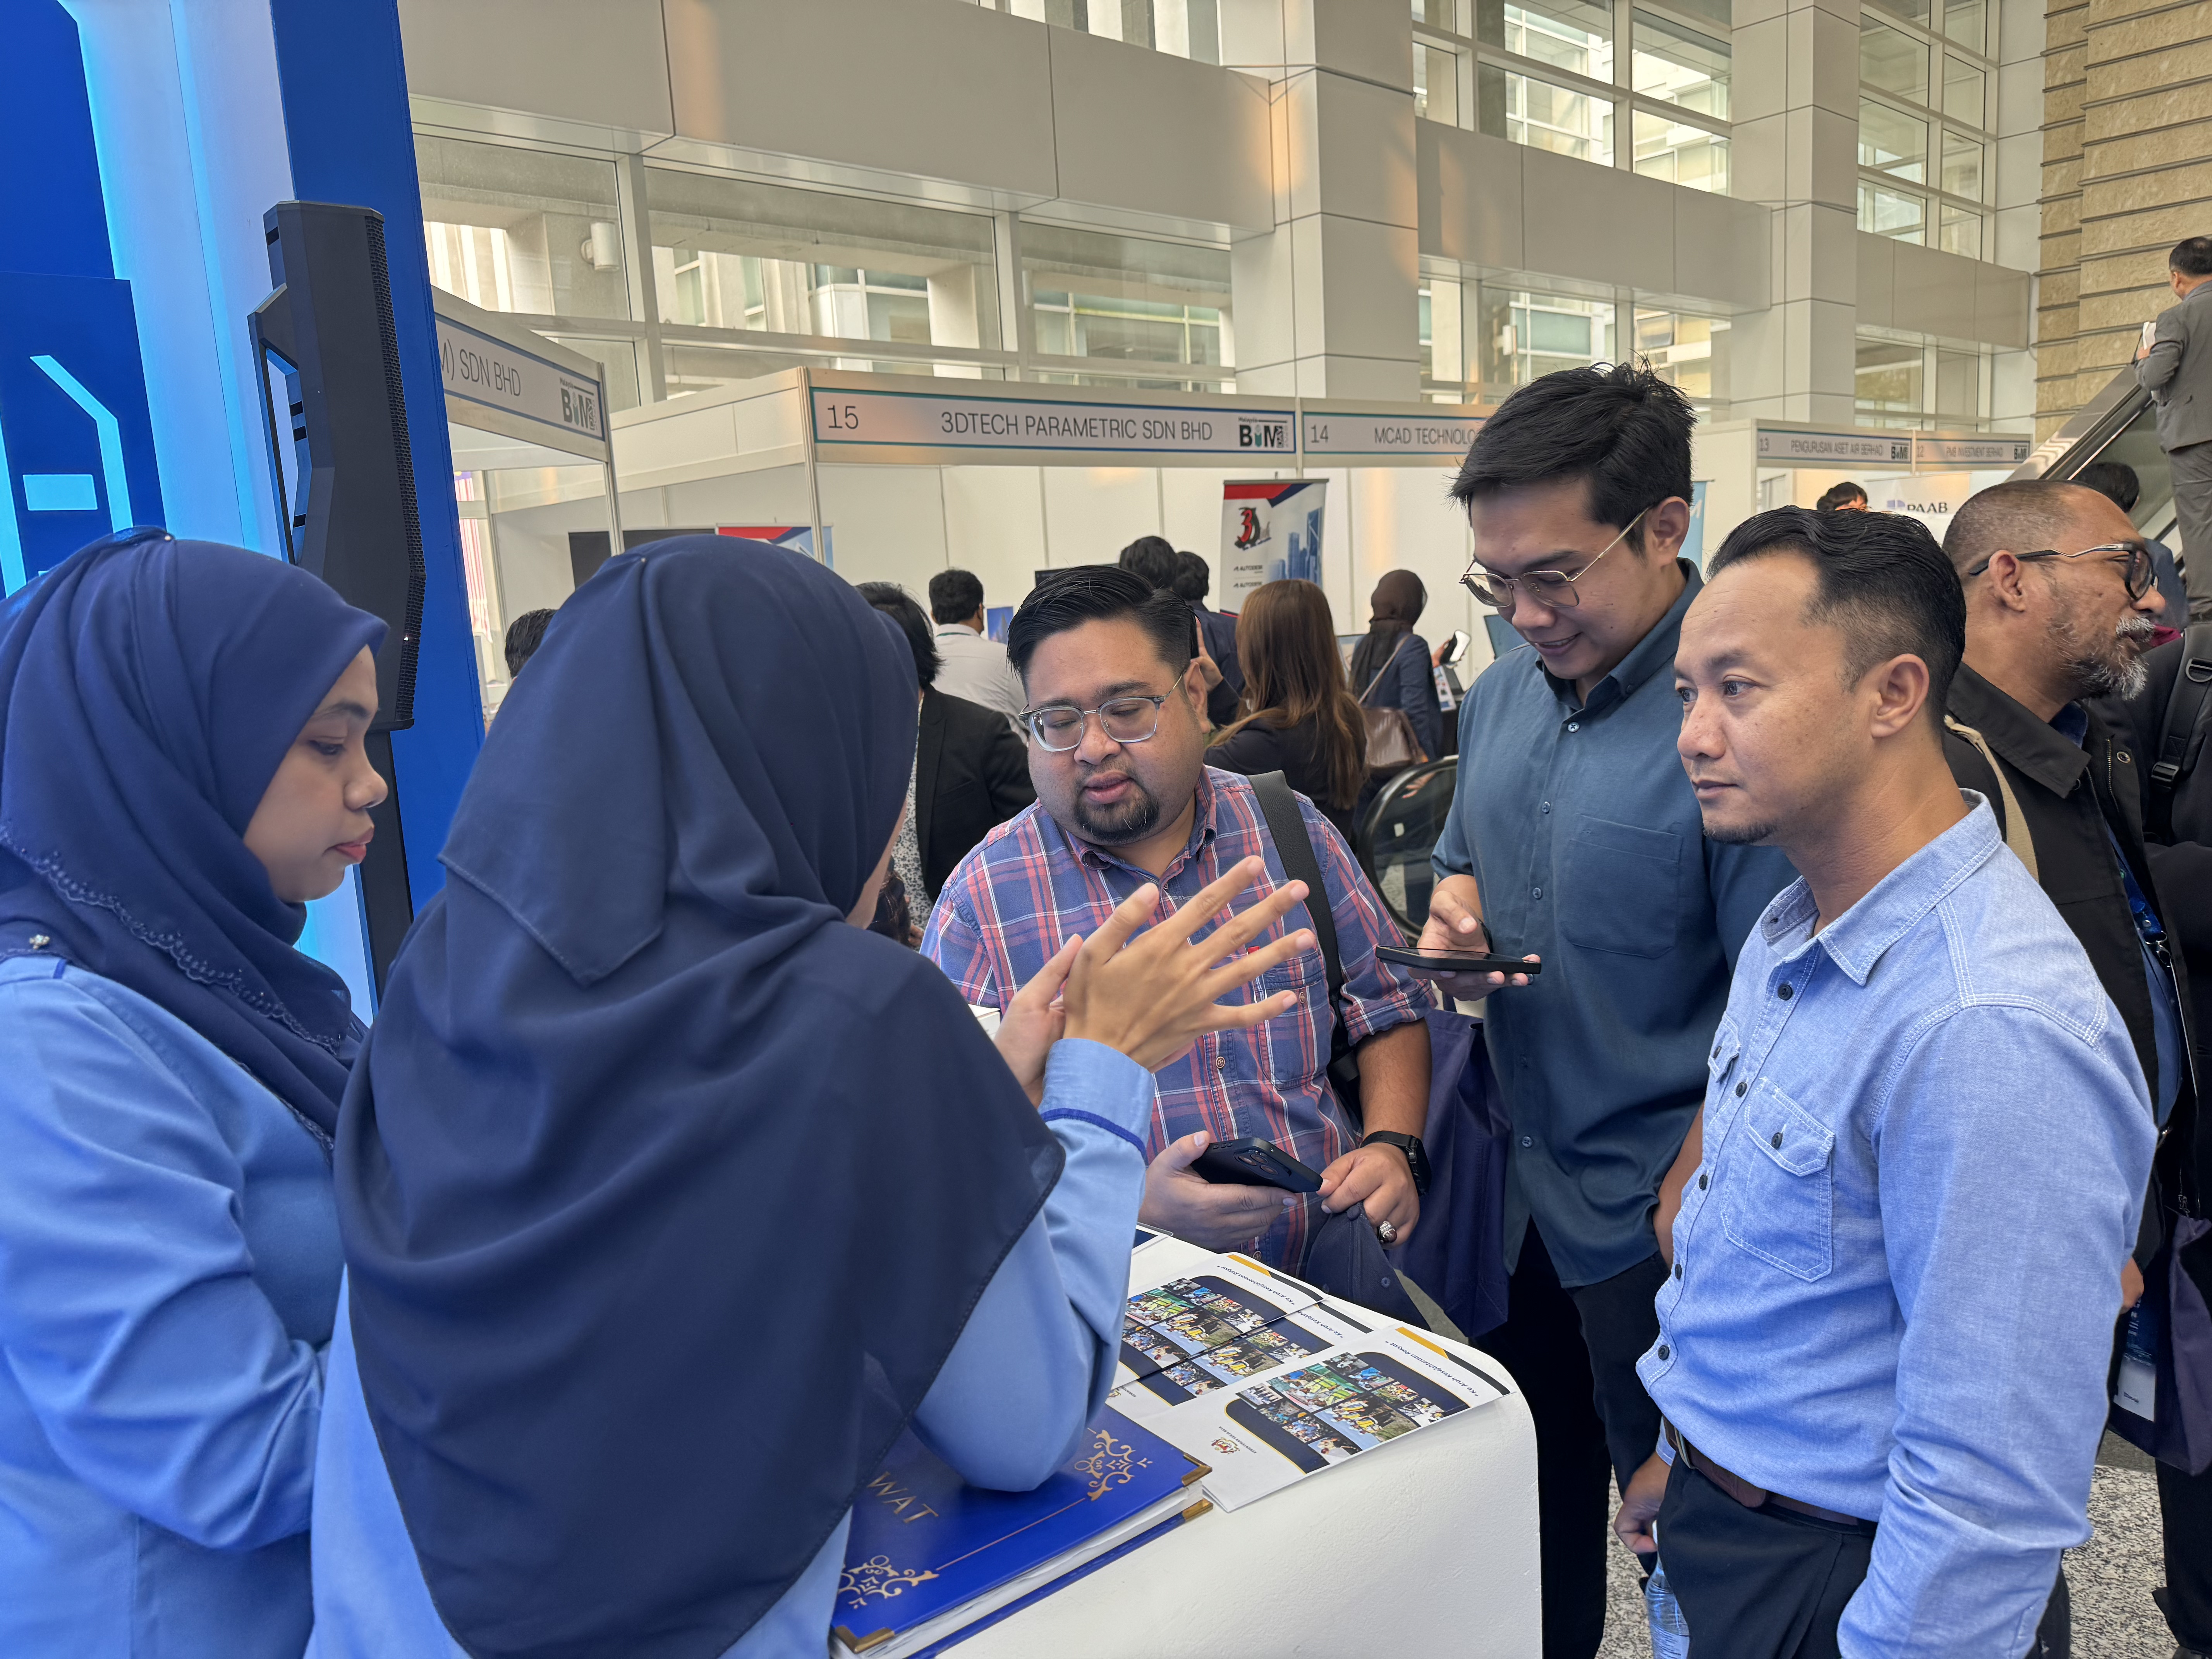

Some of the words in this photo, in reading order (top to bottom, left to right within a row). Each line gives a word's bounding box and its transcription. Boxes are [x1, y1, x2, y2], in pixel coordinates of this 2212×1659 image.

[460, 349, 490, 387] SDN
[494, 361, 520, 396] BHD
[828, 405, 859, 429] 15
[941, 412, 1018, 435] 3DTECH
[1025, 416, 1137, 439] PARAMETRIC
[1142, 420, 1175, 440] SDN
[1182, 422, 1212, 441] BHD
[1311, 425, 1329, 443] 14
[1374, 428, 1412, 444] MCAD
[1415, 428, 1475, 445] TECHNOLO
[1759, 438, 1769, 452] 13
[1917, 445, 1924, 458] 12
[1390, 1342, 1412, 1355] Rakyat
[1410, 1353, 1453, 1378] Kesejahteraan
[1452, 1377, 1468, 1387] Arah
[866, 1471, 939, 1523] WAT
